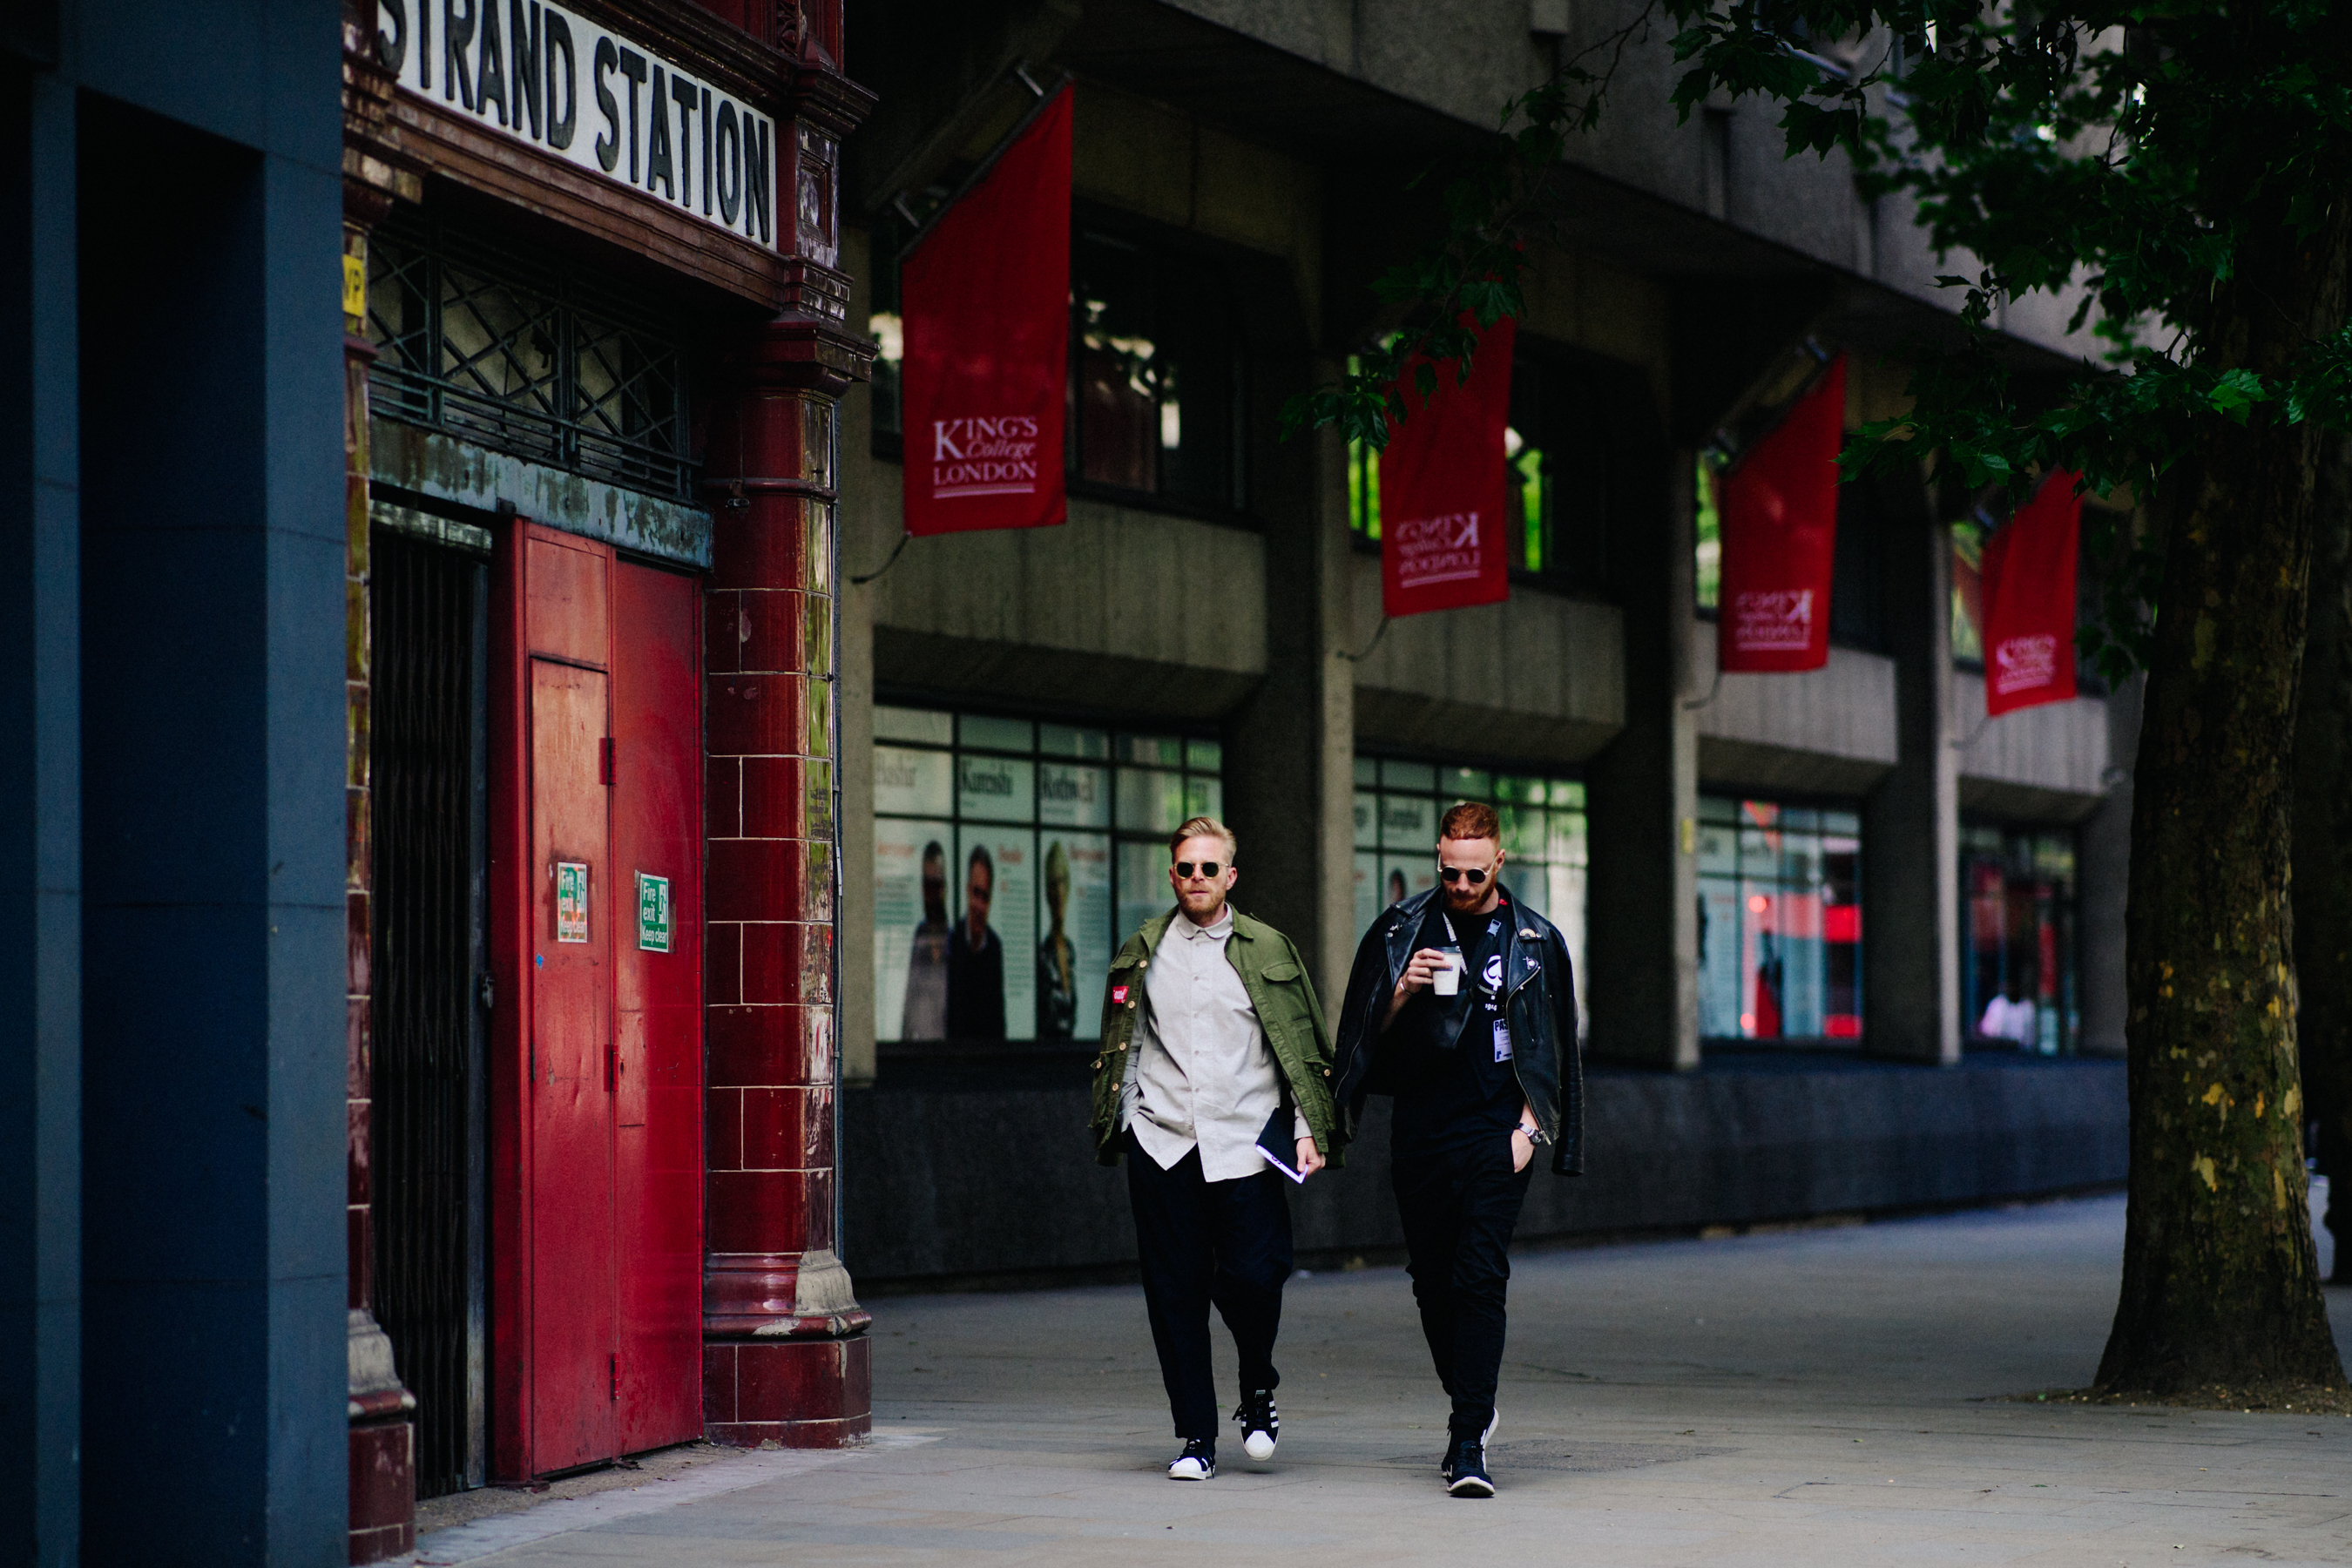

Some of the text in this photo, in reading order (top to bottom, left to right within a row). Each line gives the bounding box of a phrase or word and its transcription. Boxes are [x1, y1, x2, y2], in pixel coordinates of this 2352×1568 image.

[594, 35, 771, 243] STATION
[966, 438, 1037, 461] College
[933, 461, 1037, 486] LONDON
[561, 870, 575, 891] Fire
[643, 882, 656, 902] Fire
[562, 896, 575, 912] exit
[643, 903, 656, 923] exit
[562, 920, 585, 937] Keep clear
[642, 925, 667, 945] Keep clear
[1494, 1019, 1509, 1031] PAS
